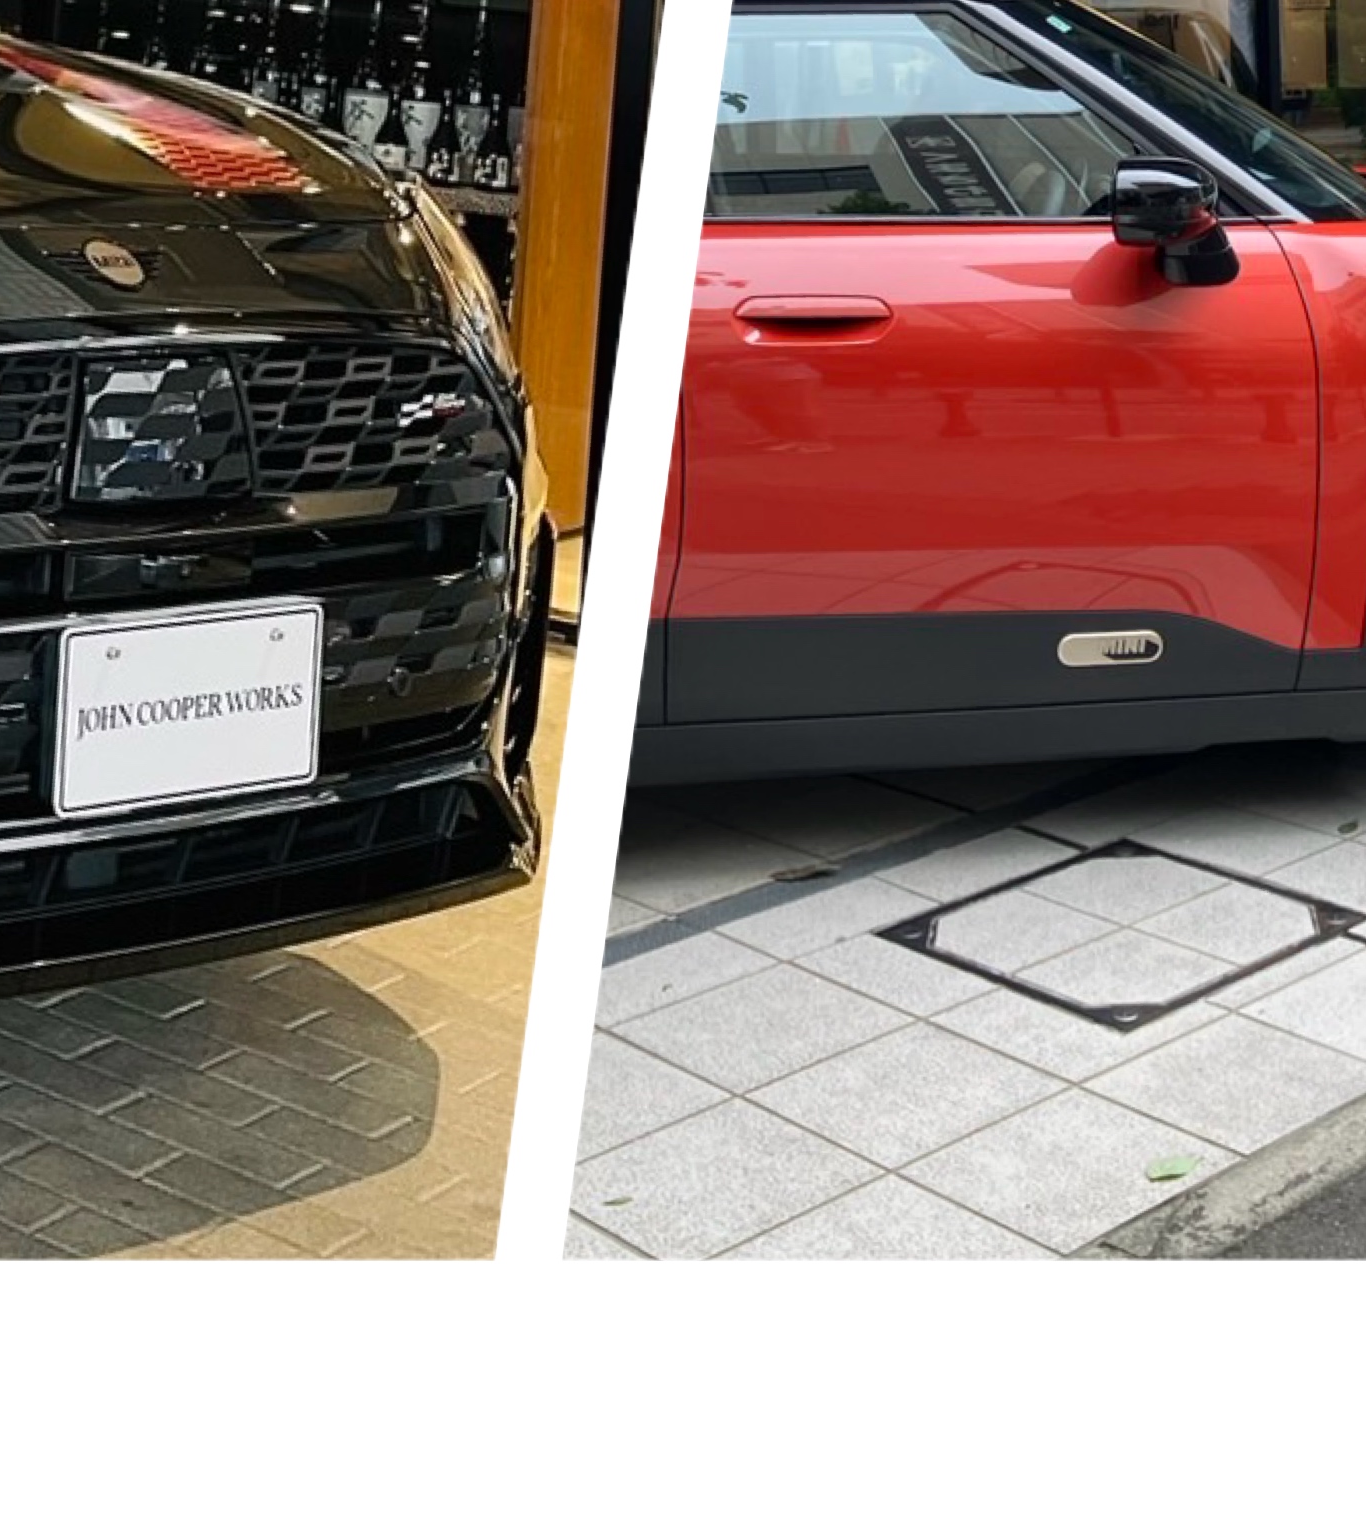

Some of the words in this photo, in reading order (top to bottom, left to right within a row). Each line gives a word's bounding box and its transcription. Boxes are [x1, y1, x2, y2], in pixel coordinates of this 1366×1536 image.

[76, 704, 133, 741] JOHN
[136, 692, 222, 726] COOPER
[225, 682, 304, 715] WORKS
